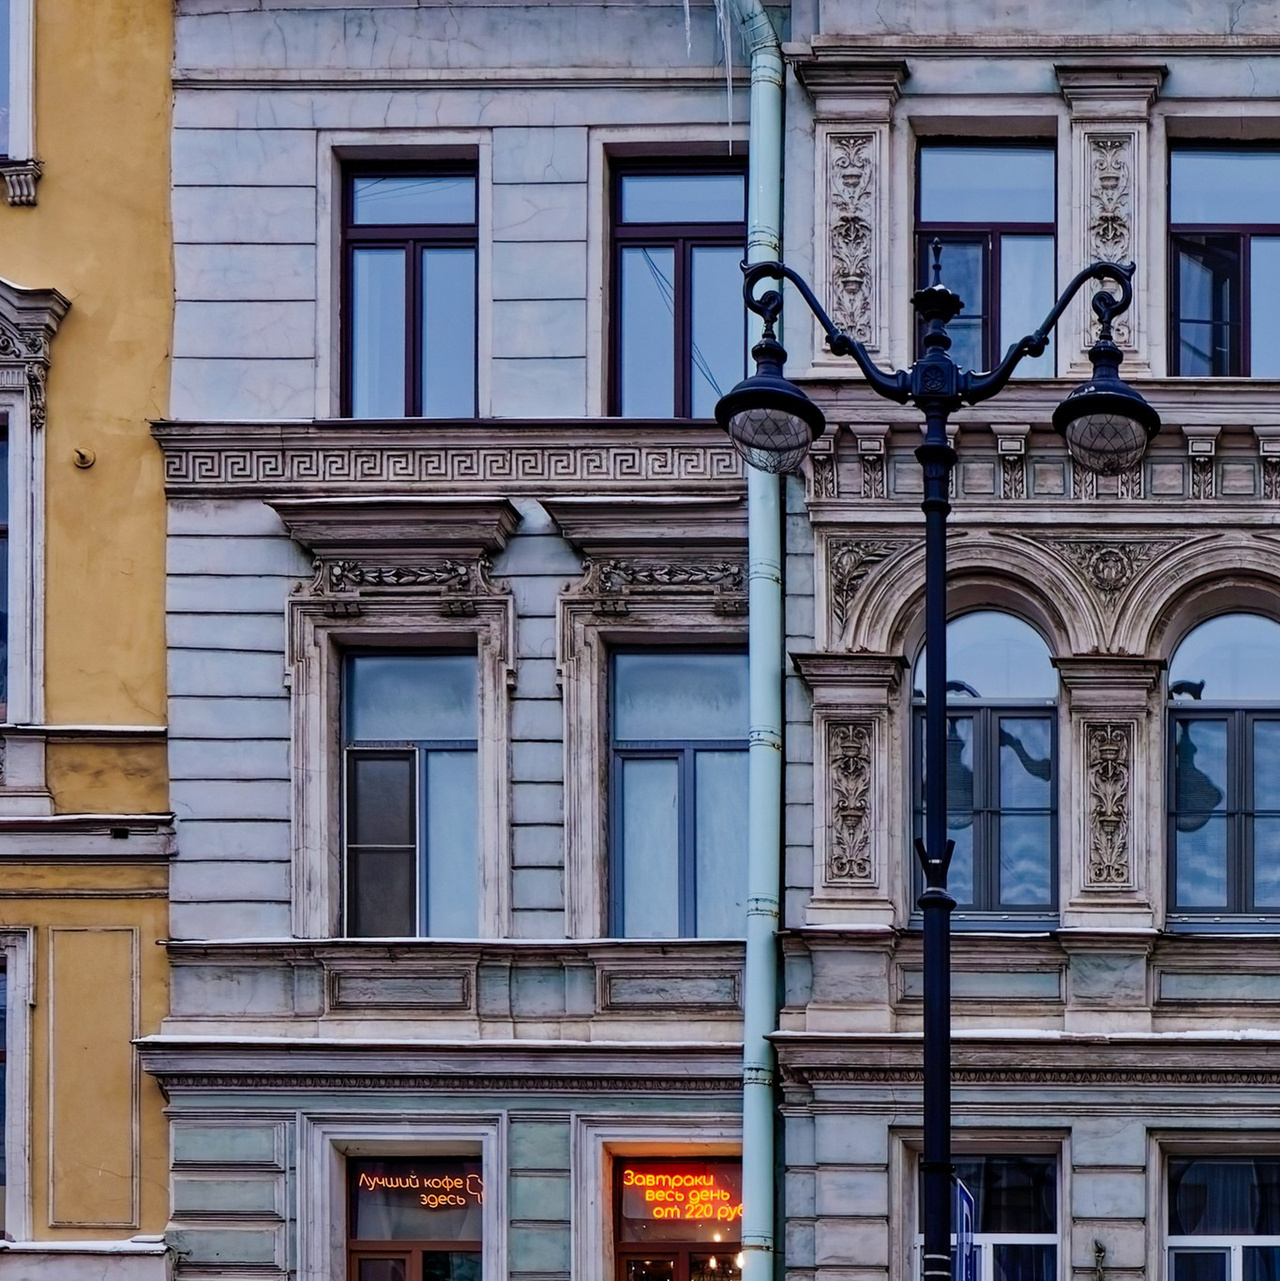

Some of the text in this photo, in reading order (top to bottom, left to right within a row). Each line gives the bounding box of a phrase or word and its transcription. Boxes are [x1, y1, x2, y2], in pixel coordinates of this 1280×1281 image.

[359, 1173, 464, 1192] Лучший кофе
[623, 1169, 714, 1189] Завтраки
[420, 1193, 466, 1208] здесь
[645, 1189, 731, 1205] весь день
[685, 1203, 713, 1219] 220
